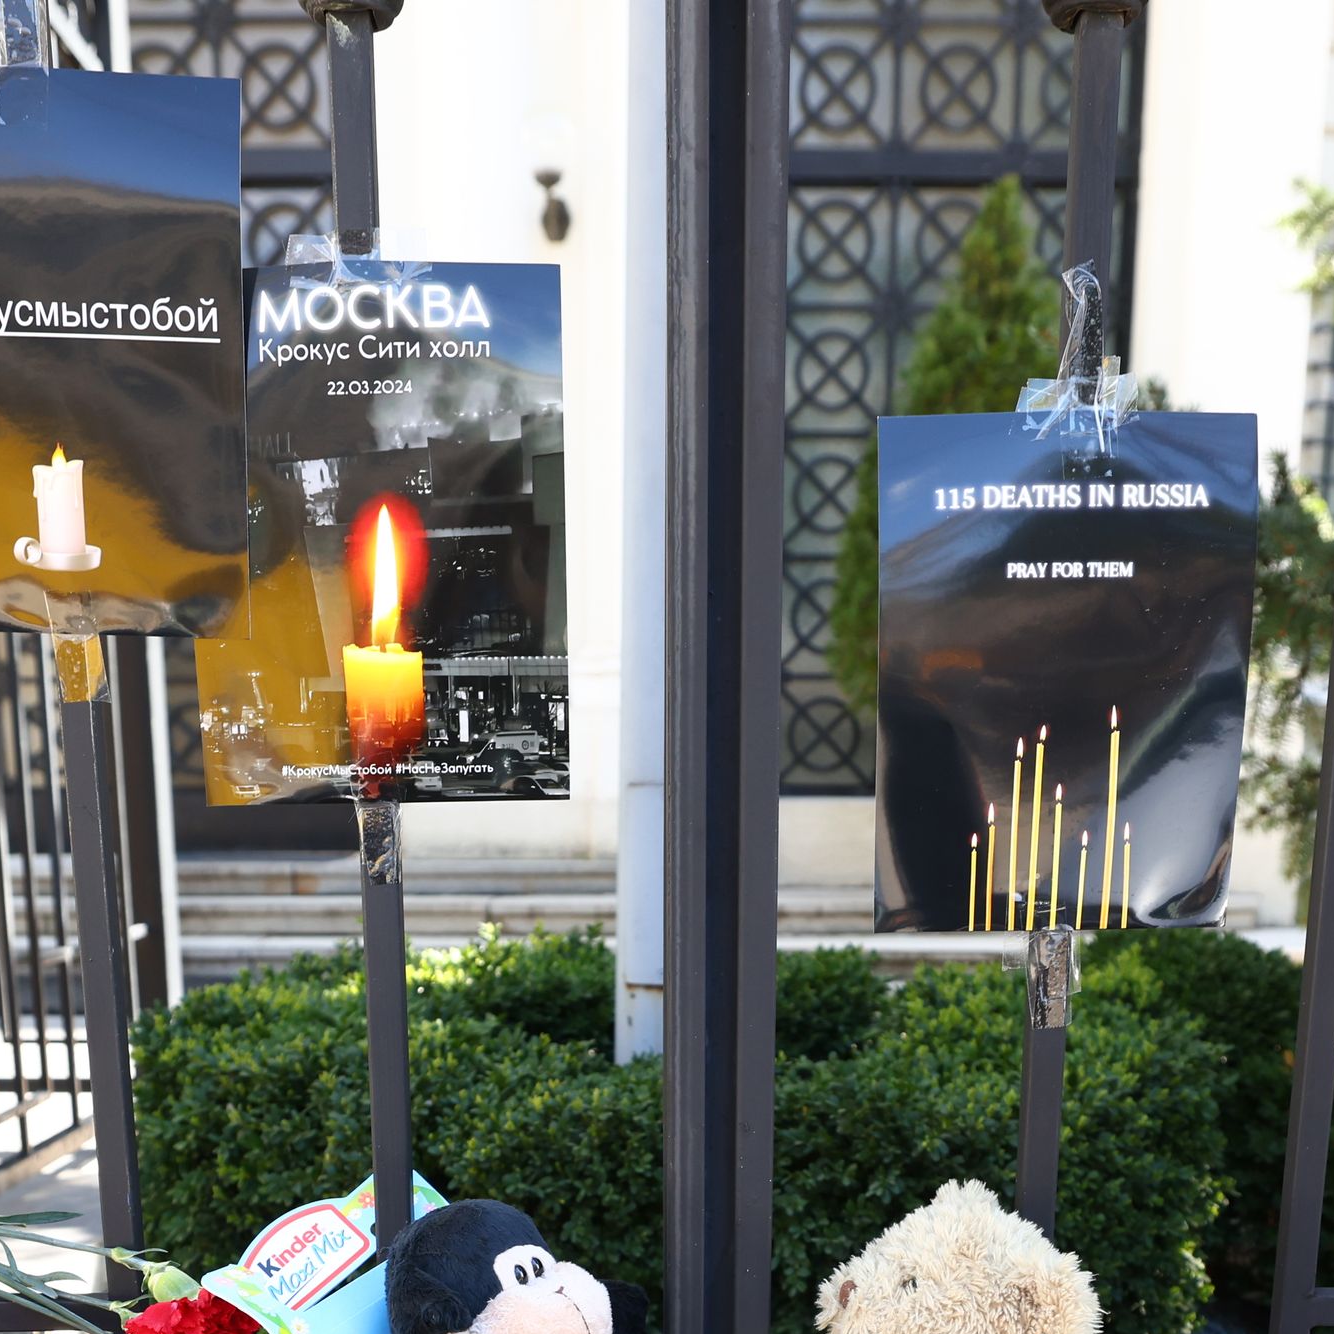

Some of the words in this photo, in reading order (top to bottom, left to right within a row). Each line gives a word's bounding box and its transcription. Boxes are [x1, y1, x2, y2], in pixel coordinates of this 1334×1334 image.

[257, 284, 492, 333] МОСКВА
[258, 338, 351, 368] Крокус
[358, 334, 421, 360] Сити
[429, 340, 491, 359] холл
[326, 378, 414, 396] 22.03.2024
[934, 486, 977, 510] 115
[982, 484, 1082, 509] DEATHS
[1087, 484, 1116, 508] IN
[1121, 483, 1210, 508] RUSSIA
[1006, 562, 1049, 579] PRAY
[1051, 562, 1084, 578] FOR
[1086, 561, 1134, 578] THEM
[257, 1223, 322, 1278] Kinder
[268, 1256, 319, 1302] Maxi
[311, 1229, 352, 1265] Mix
